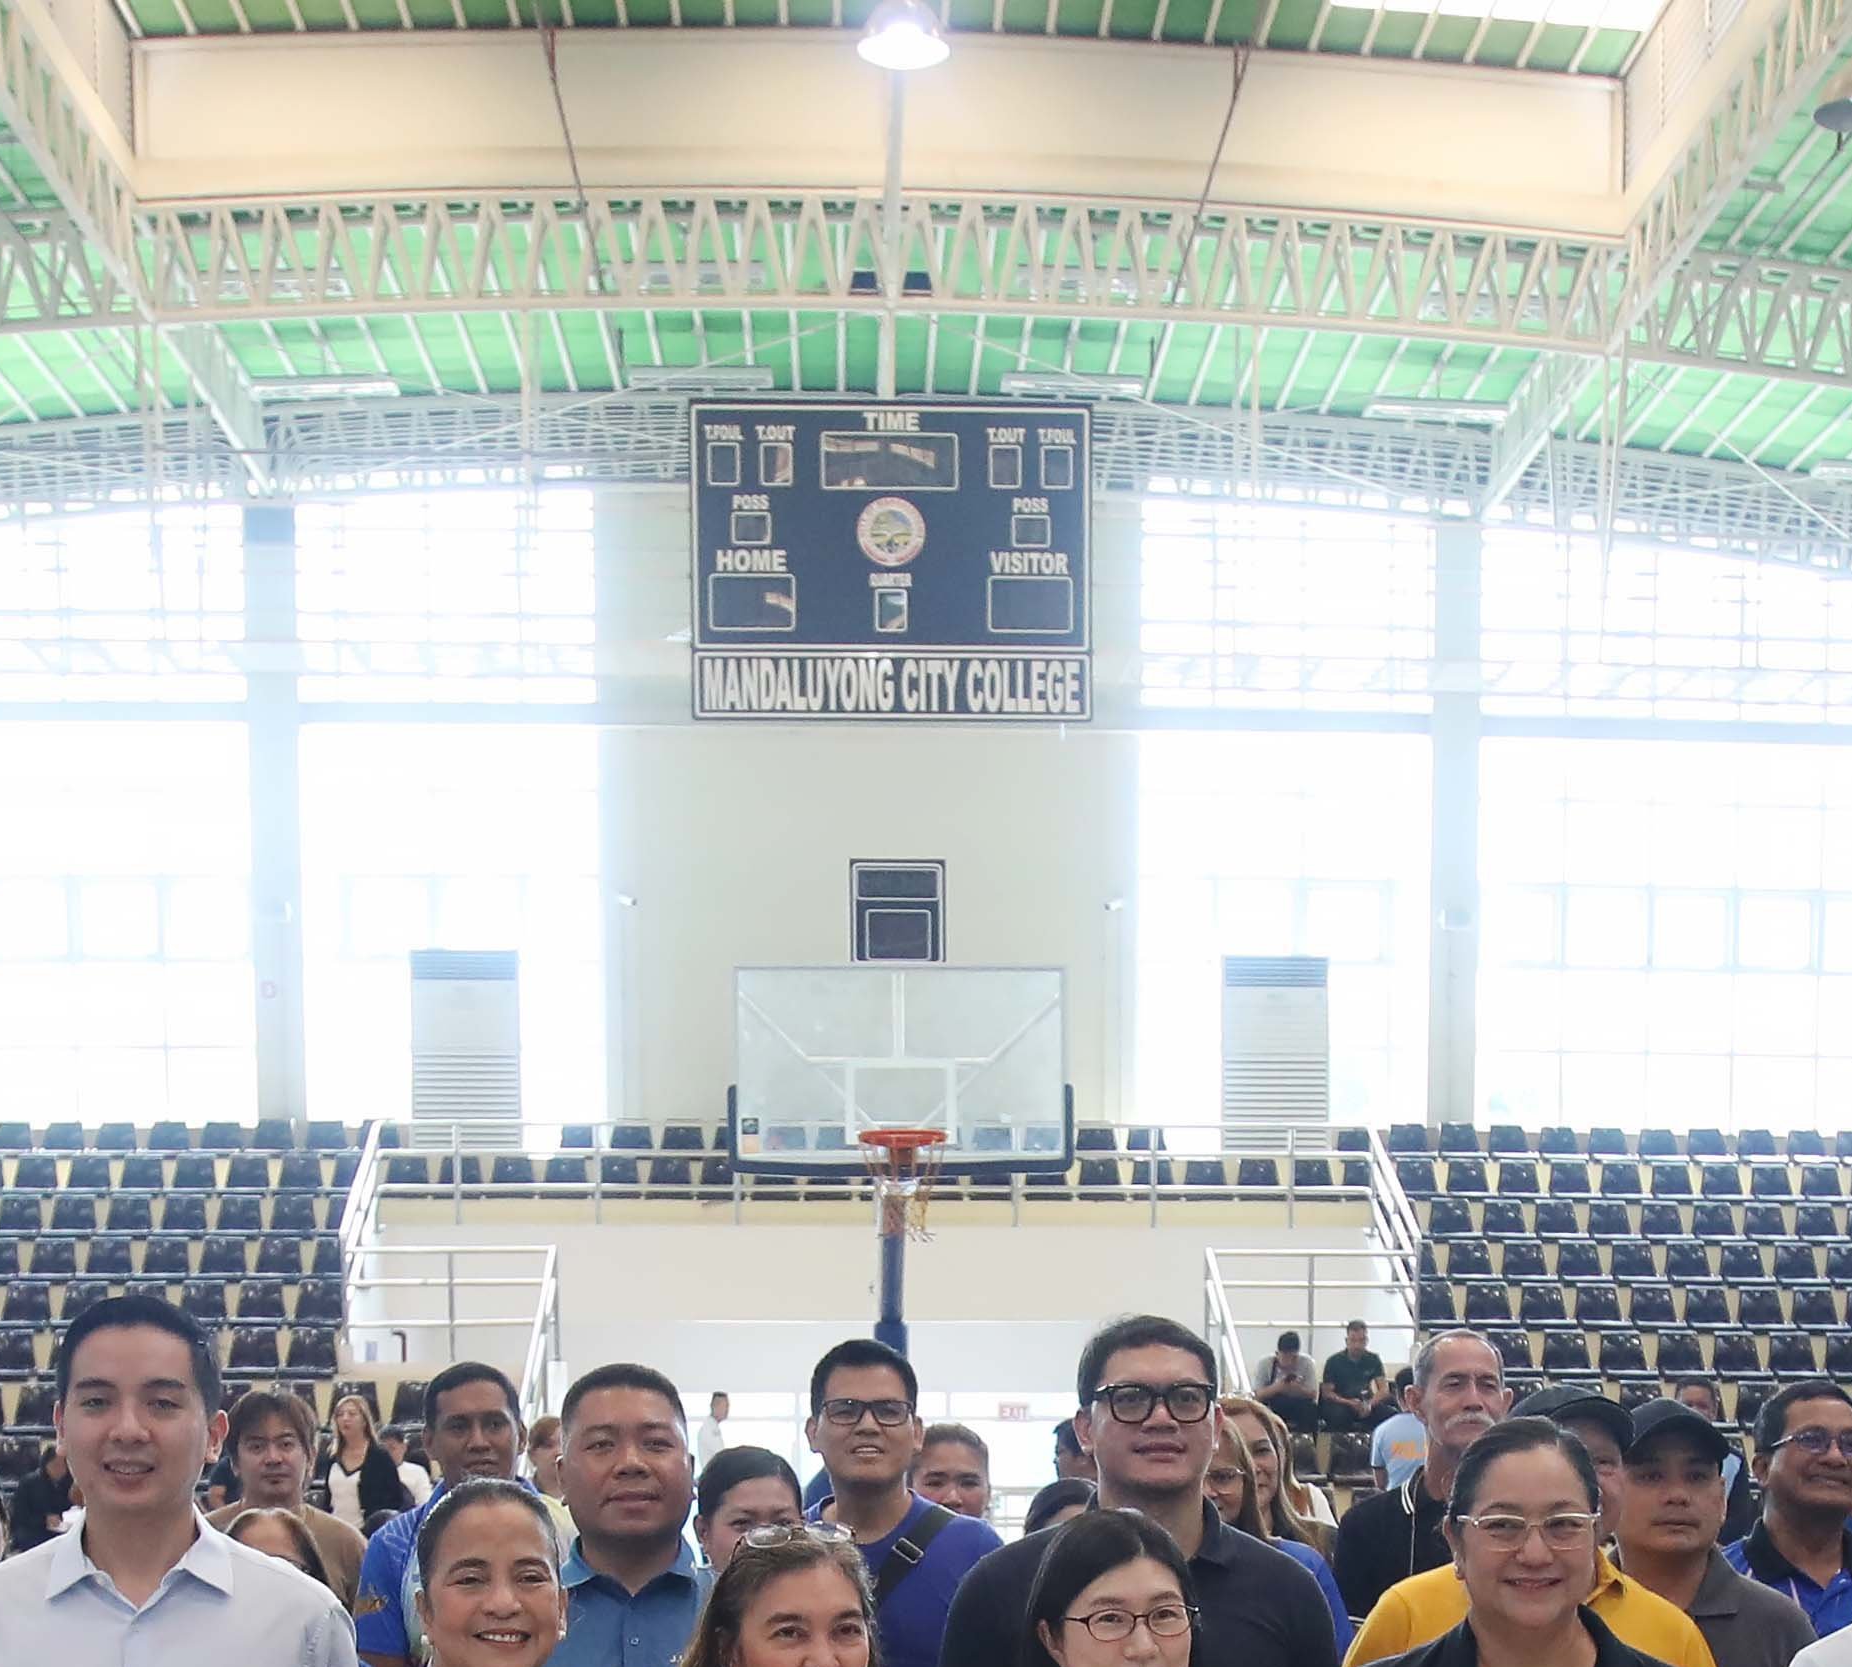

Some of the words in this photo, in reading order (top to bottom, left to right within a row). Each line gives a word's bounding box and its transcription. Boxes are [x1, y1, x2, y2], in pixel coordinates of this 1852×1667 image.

[863, 411, 920, 431] TIME
[756, 424, 796, 442] T.OUT
[986, 427, 1026, 444] T.OUT
[732, 494, 770, 510] POSS
[1012, 497, 1049, 514] POSS
[715, 549, 787, 572] HOME
[990, 551, 1068, 575] VISITOR
[703, 658, 895, 712] MANDALUYONG
[901, 659, 961, 711] CITY
[967, 659, 1081, 711] COLLEGE
